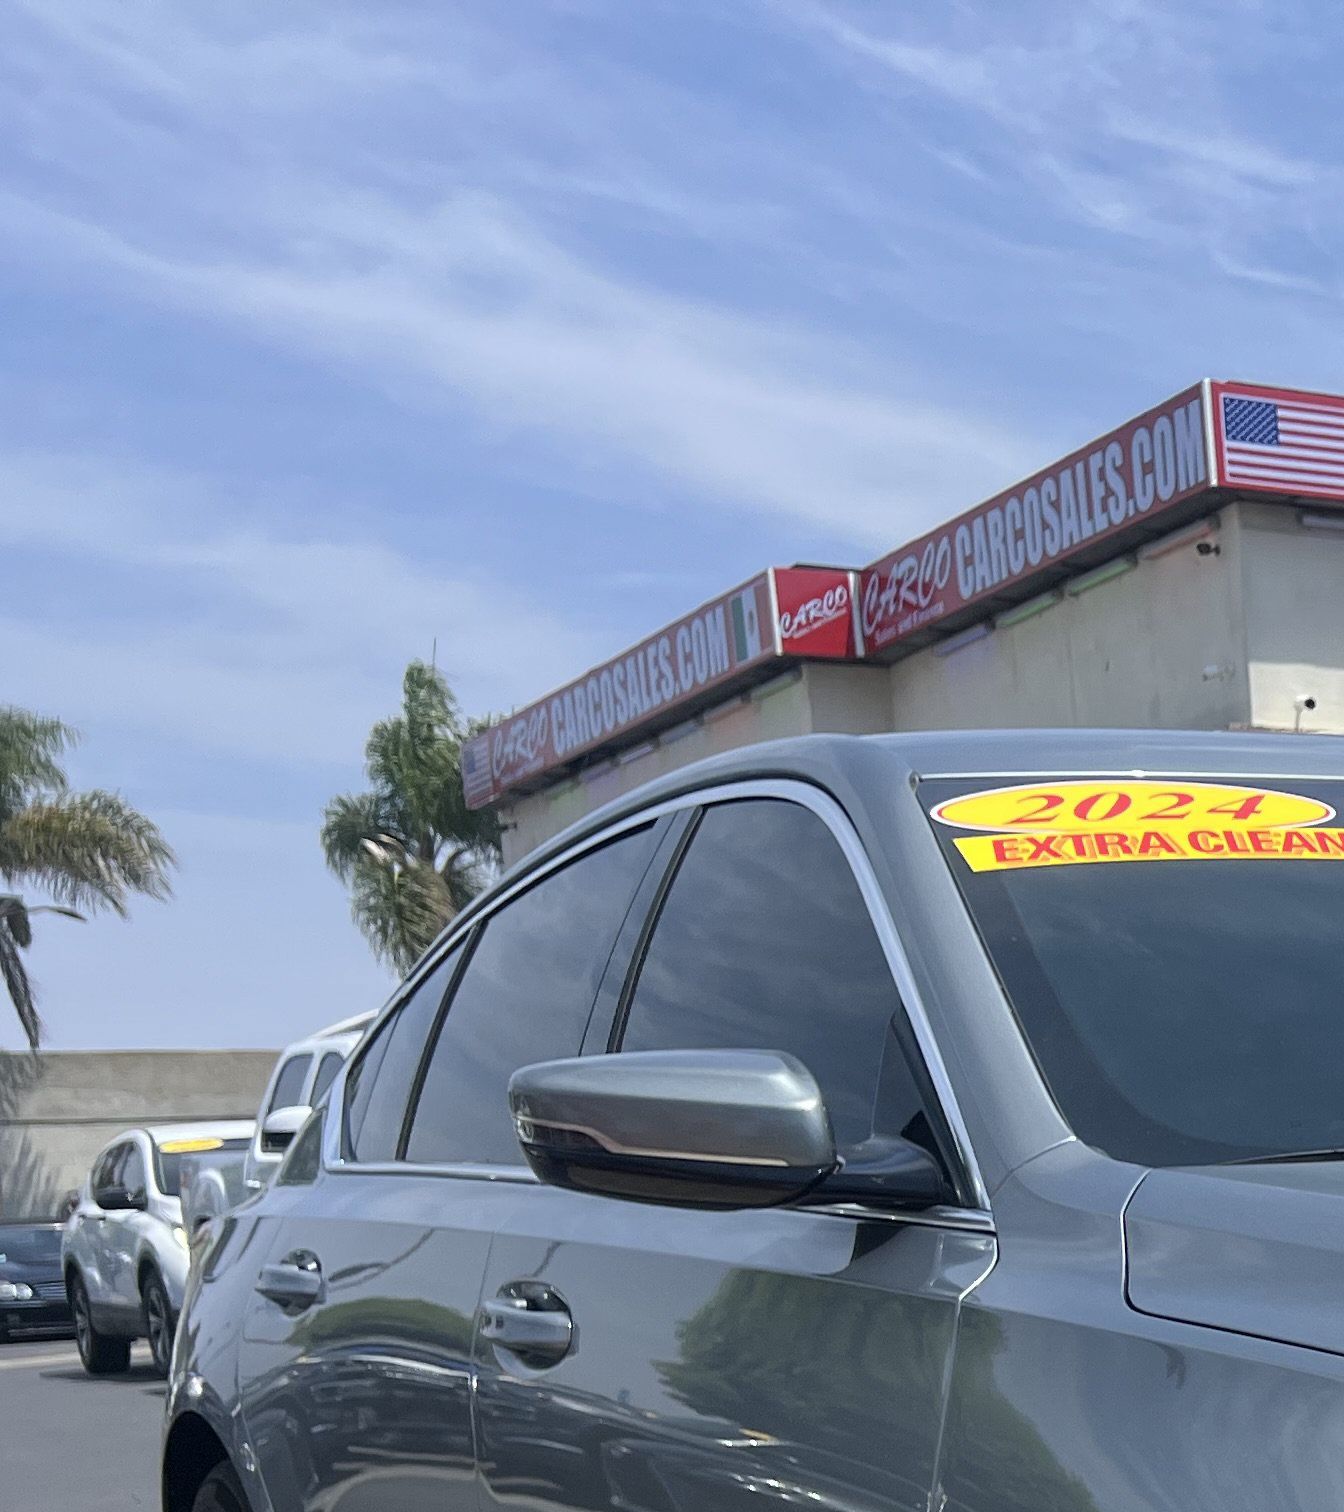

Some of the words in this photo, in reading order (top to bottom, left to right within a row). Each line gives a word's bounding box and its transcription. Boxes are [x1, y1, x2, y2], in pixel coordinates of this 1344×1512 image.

[863, 535, 951, 637] CARCO
[955, 399, 1205, 600] CARCOSALES.COM
[780, 584, 848, 638] CARCO
[492, 703, 549, 775] CARCO
[551, 604, 730, 757] CARCOSALES.COM
[1004, 791, 1266, 825] 2024
[993, 830, 1178, 864] EXTRA
